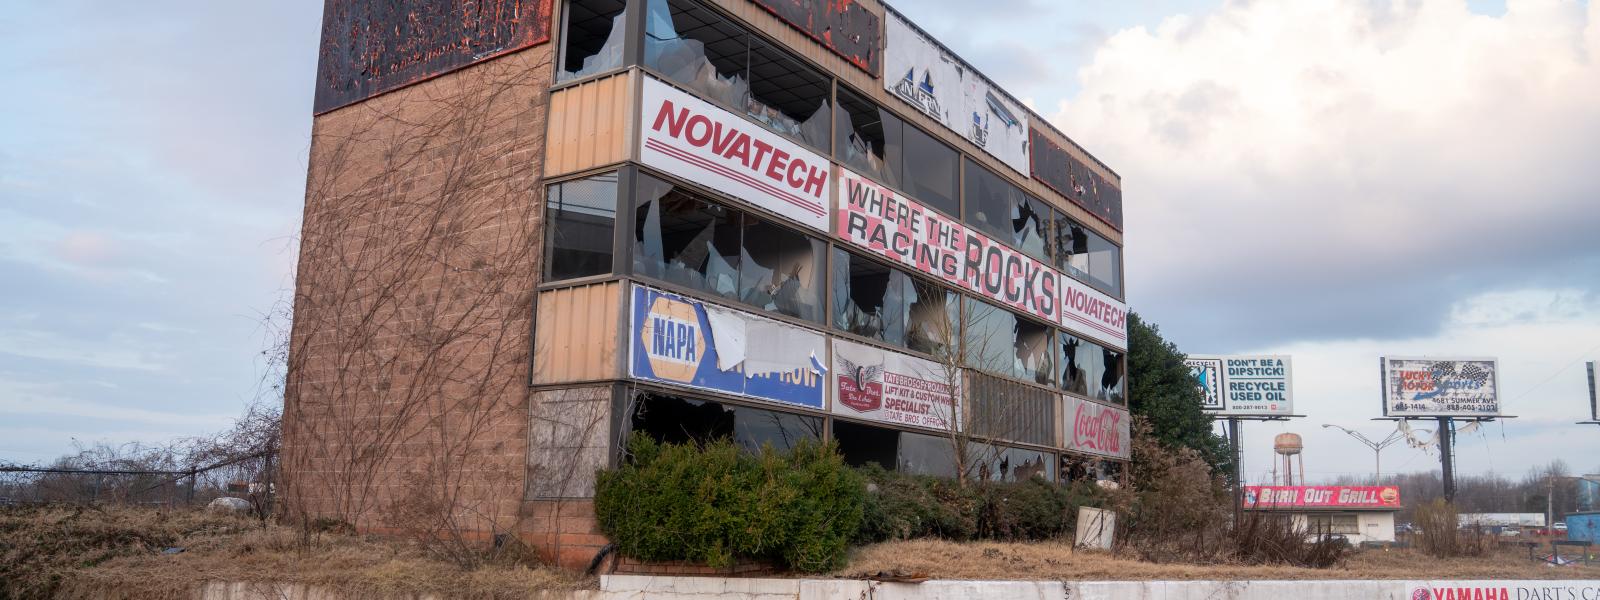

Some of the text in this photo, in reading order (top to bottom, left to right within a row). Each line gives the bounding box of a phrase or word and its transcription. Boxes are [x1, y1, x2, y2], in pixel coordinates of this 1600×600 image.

[652, 100, 827, 198] NOVATECH
[848, 178, 960, 251] WHERE THE
[848, 211, 957, 276] RACING
[964, 234, 1055, 316] ROCKS
[1064, 286, 1126, 330] NOVATECH
[653, 317, 696, 363] NAPA
[1227, 359, 1284, 367] DON'T BE A
[1228, 367, 1284, 376] DIPSTICK!
[1399, 370, 1432, 380] LUCKY
[1229, 382, 1285, 391] RECYCLE
[885, 385, 898, 396] LIFT
[899, 387, 910, 398] KIT
[915, 390, 941, 403] CUSTOM
[940, 394, 960, 407] WHL
[1230, 392, 1286, 401] USED OIL
[885, 397, 931, 415] SPECIALIST
[905, 413, 920, 424] BROS
[1433, 587, 1509, 600] YAMAHA
[1516, 587, 1576, 600] DART'S
